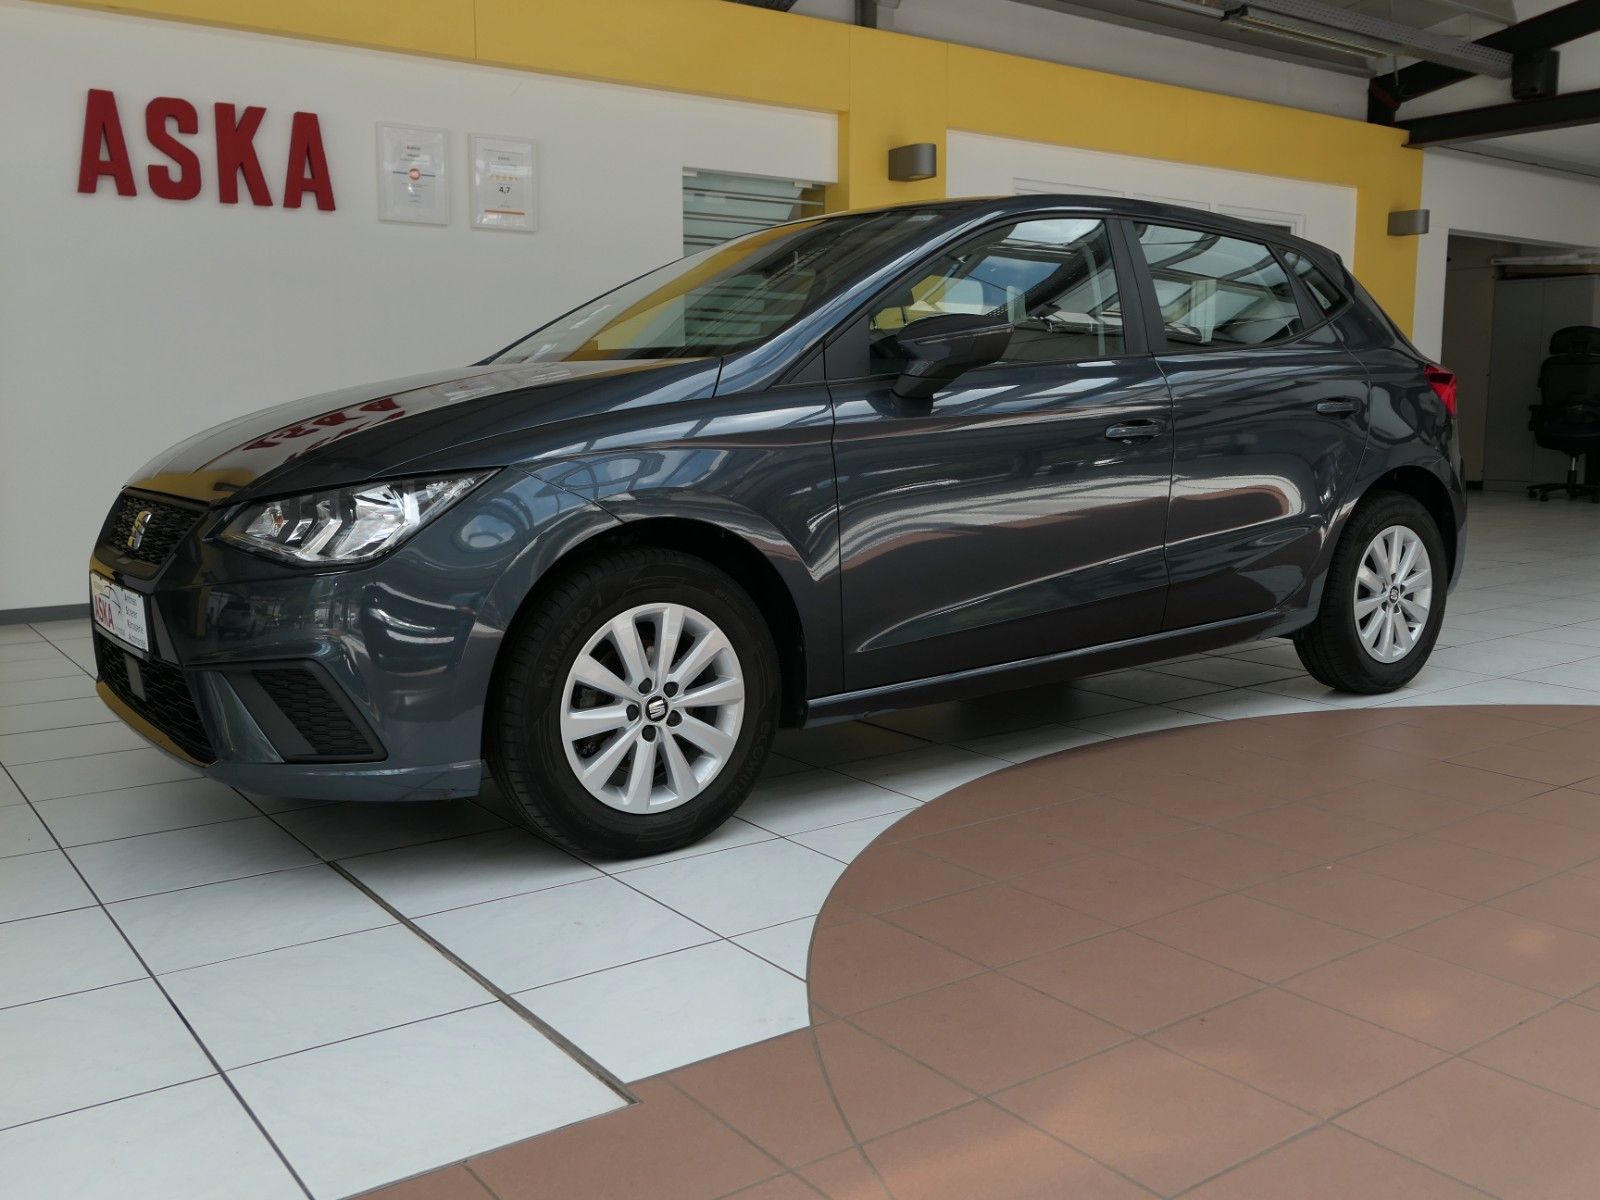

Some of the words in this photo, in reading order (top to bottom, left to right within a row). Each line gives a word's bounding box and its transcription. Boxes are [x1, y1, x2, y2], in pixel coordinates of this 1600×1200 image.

[78, 88, 336, 211] ASKA
[498, 186, 511, 194] 4,7
[94, 594, 115, 631] ASKA
[537, 606, 592, 688] KUMHO
